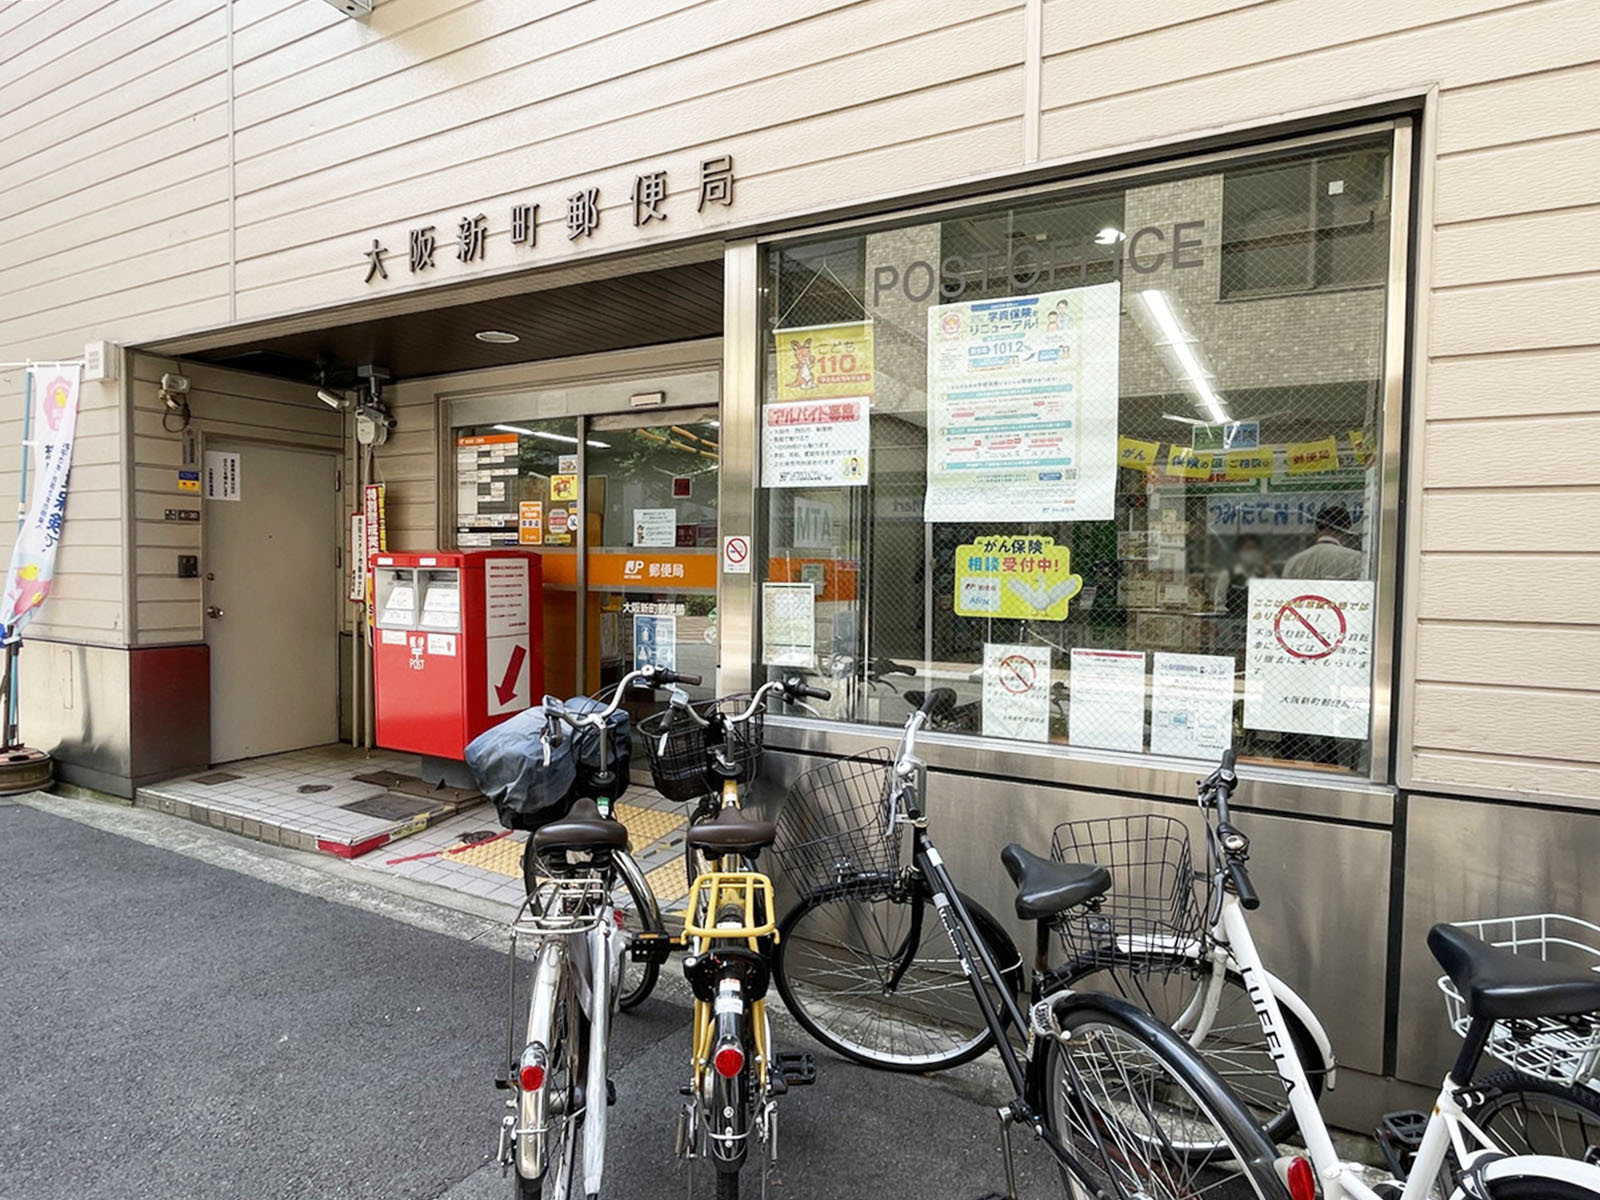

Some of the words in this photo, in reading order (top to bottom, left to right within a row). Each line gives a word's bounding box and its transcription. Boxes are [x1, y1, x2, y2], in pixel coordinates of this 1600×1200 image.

[363, 153, 734, 284] 大阪新町郵便局
[874, 250, 1000, 307] POST
[817, 354, 857, 374] 110
[649, 563, 684, 578] 郵便局
[967, 556, 1059, 573] 相談受付中!
[622, 601, 685, 616] 大阪新町郵便局
